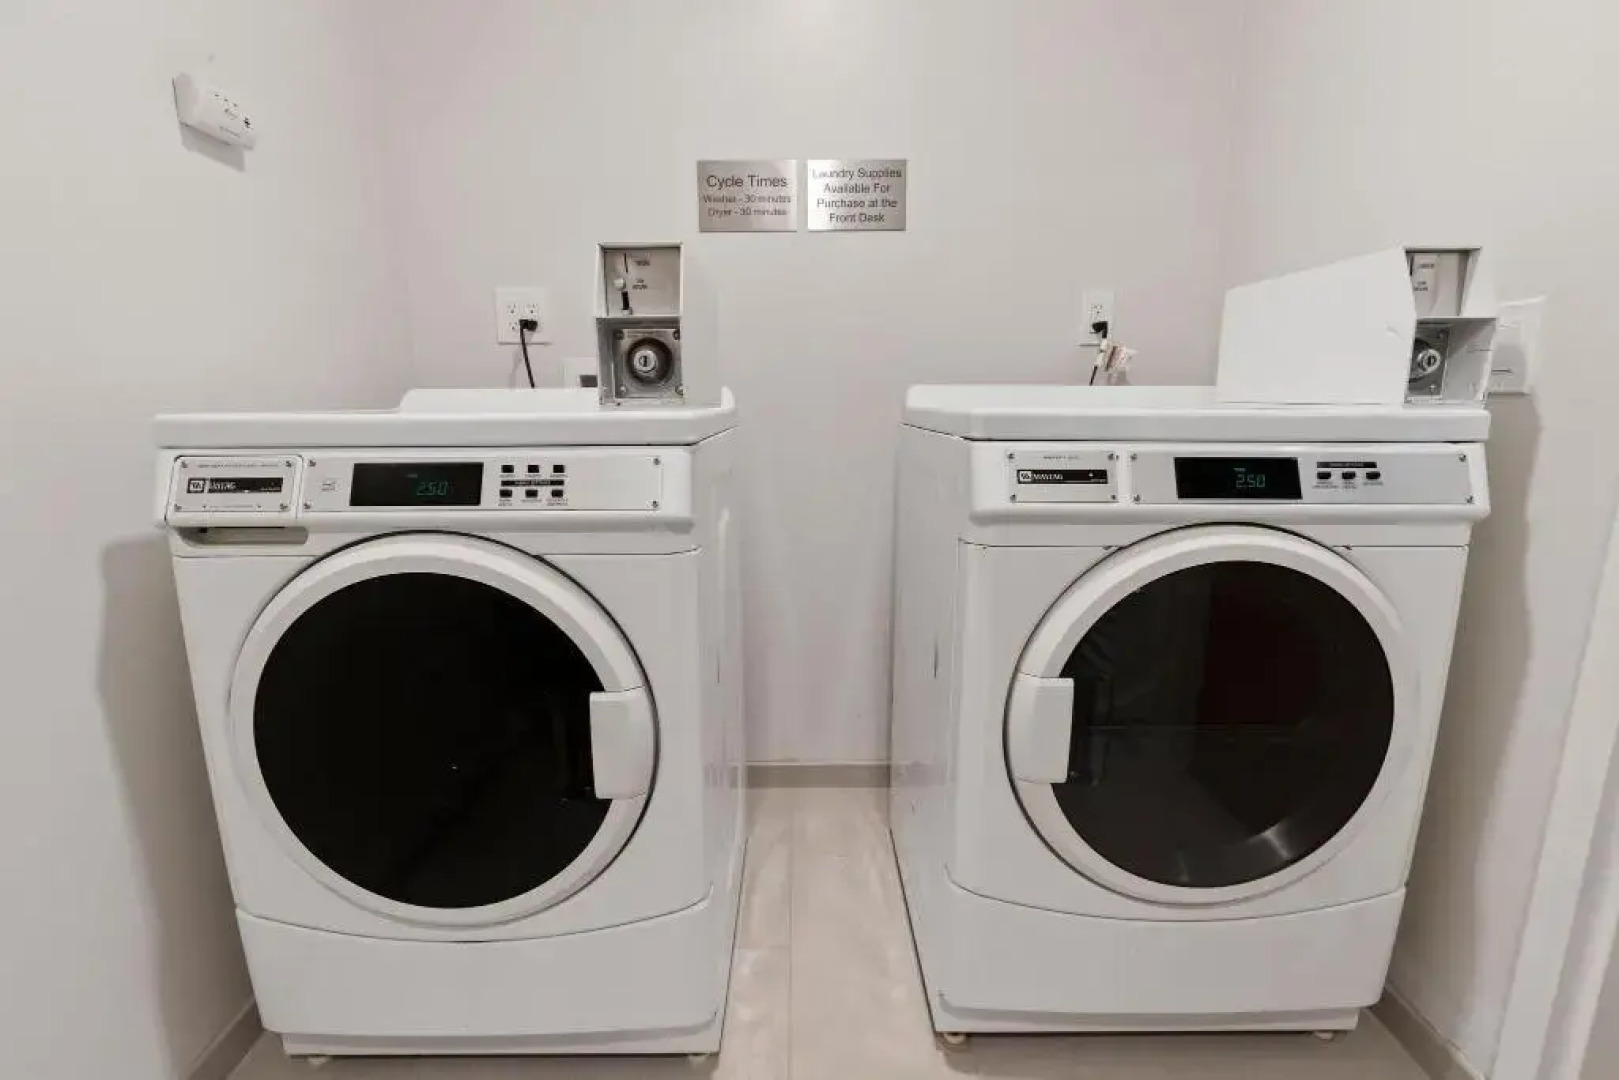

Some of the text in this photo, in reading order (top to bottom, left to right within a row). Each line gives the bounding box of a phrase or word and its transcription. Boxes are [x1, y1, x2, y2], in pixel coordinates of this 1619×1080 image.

[812, 168, 902, 181] Laundry Supplies
[706, 174, 789, 190] Cycle Times
[824, 183, 890, 194] Available For
[745, 195, 756, 203] 30
[758, 195, 791, 203] minutes
[817, 198, 898, 208] Purchase at the
[708, 207, 732, 218] Dryer
[740, 207, 752, 216] 30
[753, 208, 788, 216] minutes
[830, 213, 885, 222] Front Desk
